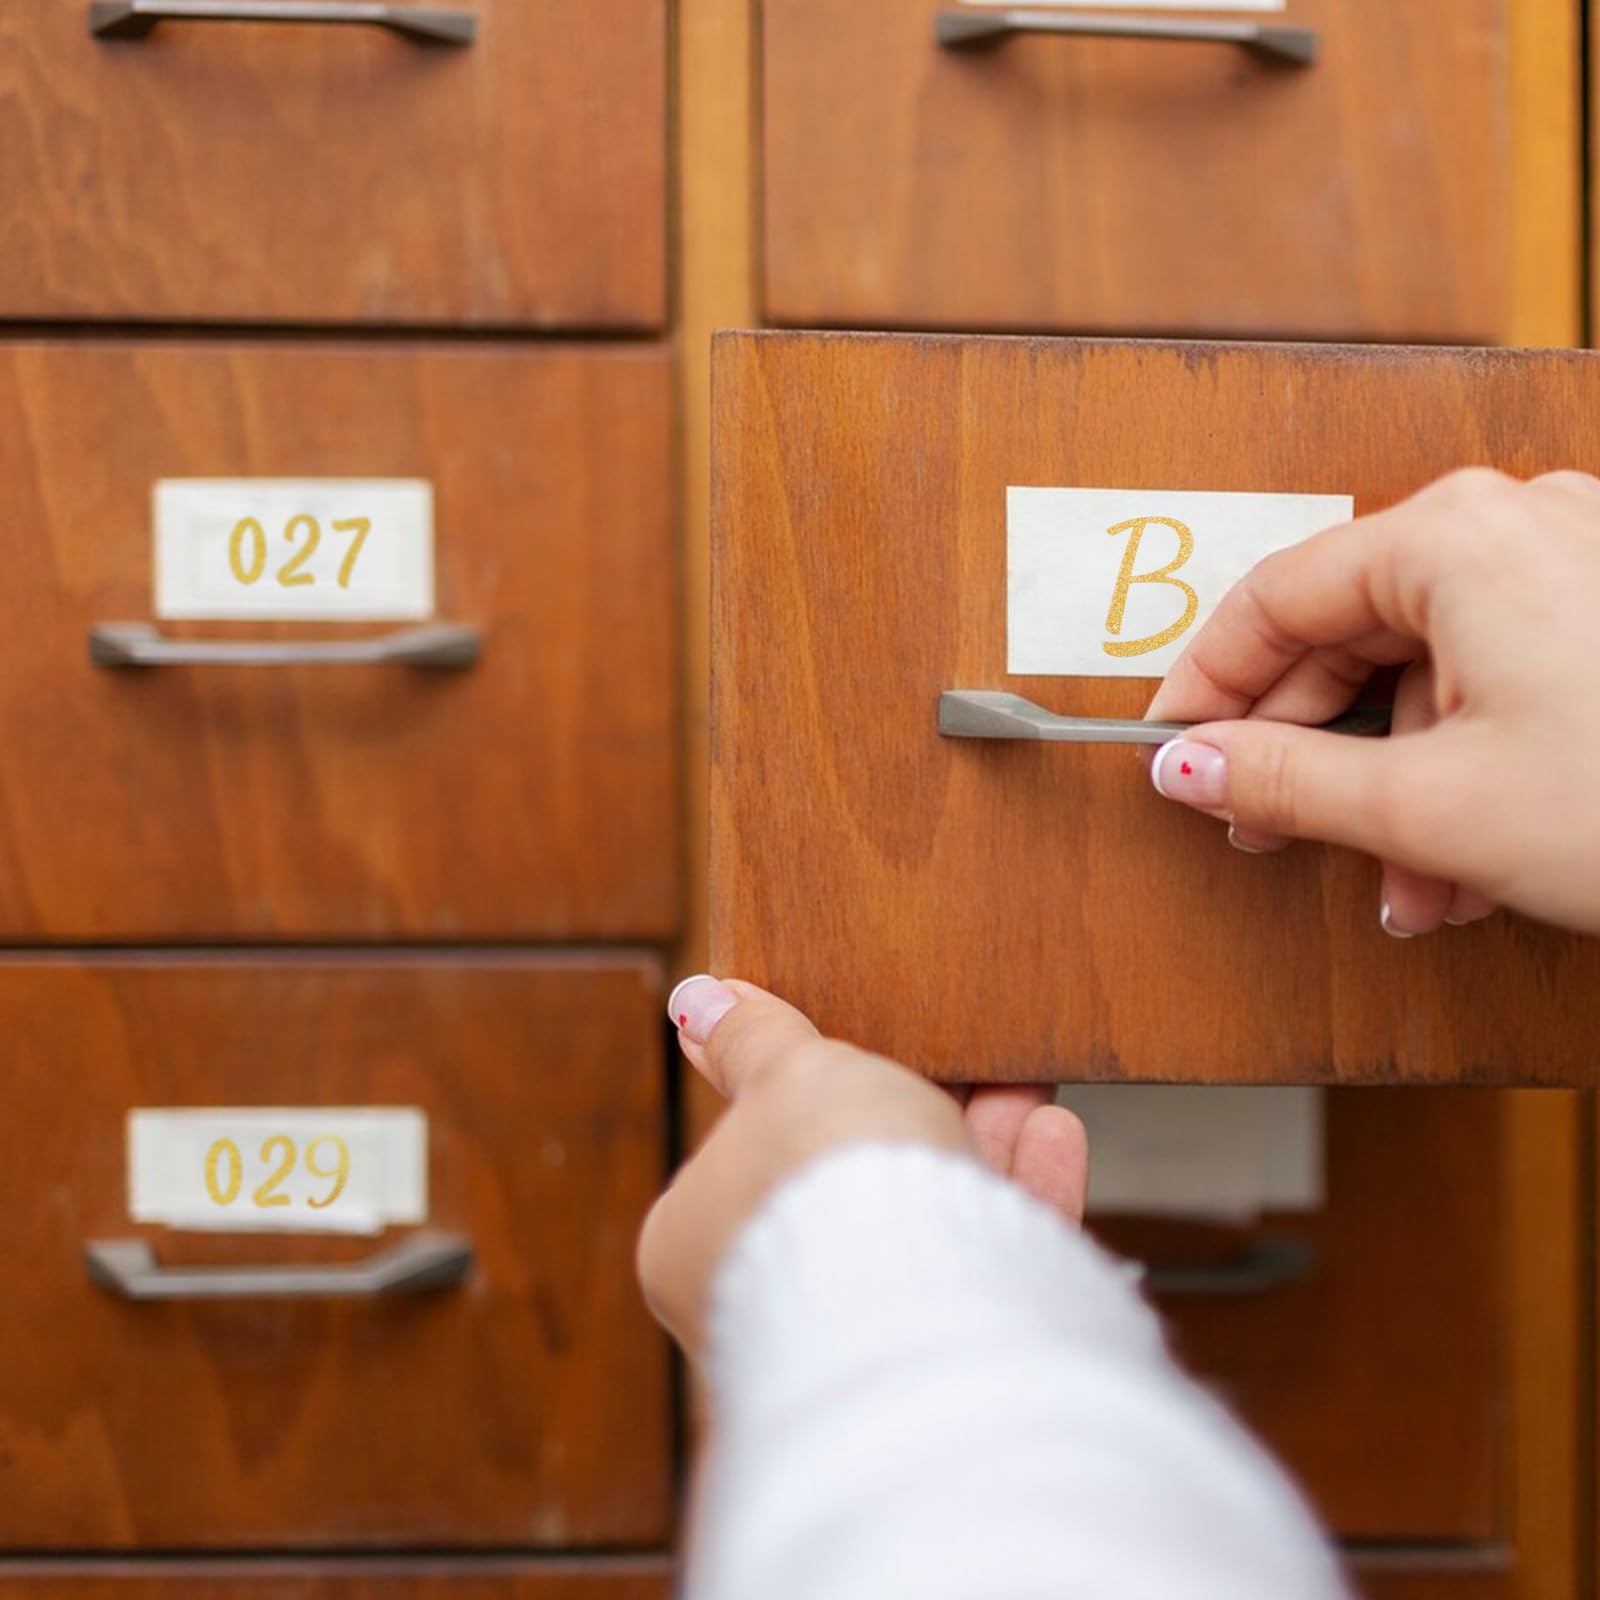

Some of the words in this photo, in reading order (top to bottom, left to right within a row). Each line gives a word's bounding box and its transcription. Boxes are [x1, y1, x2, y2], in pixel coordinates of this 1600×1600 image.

[228, 513, 371, 589] 027
[1102, 515, 1199, 657] B
[203, 1132, 351, 1209] 029
